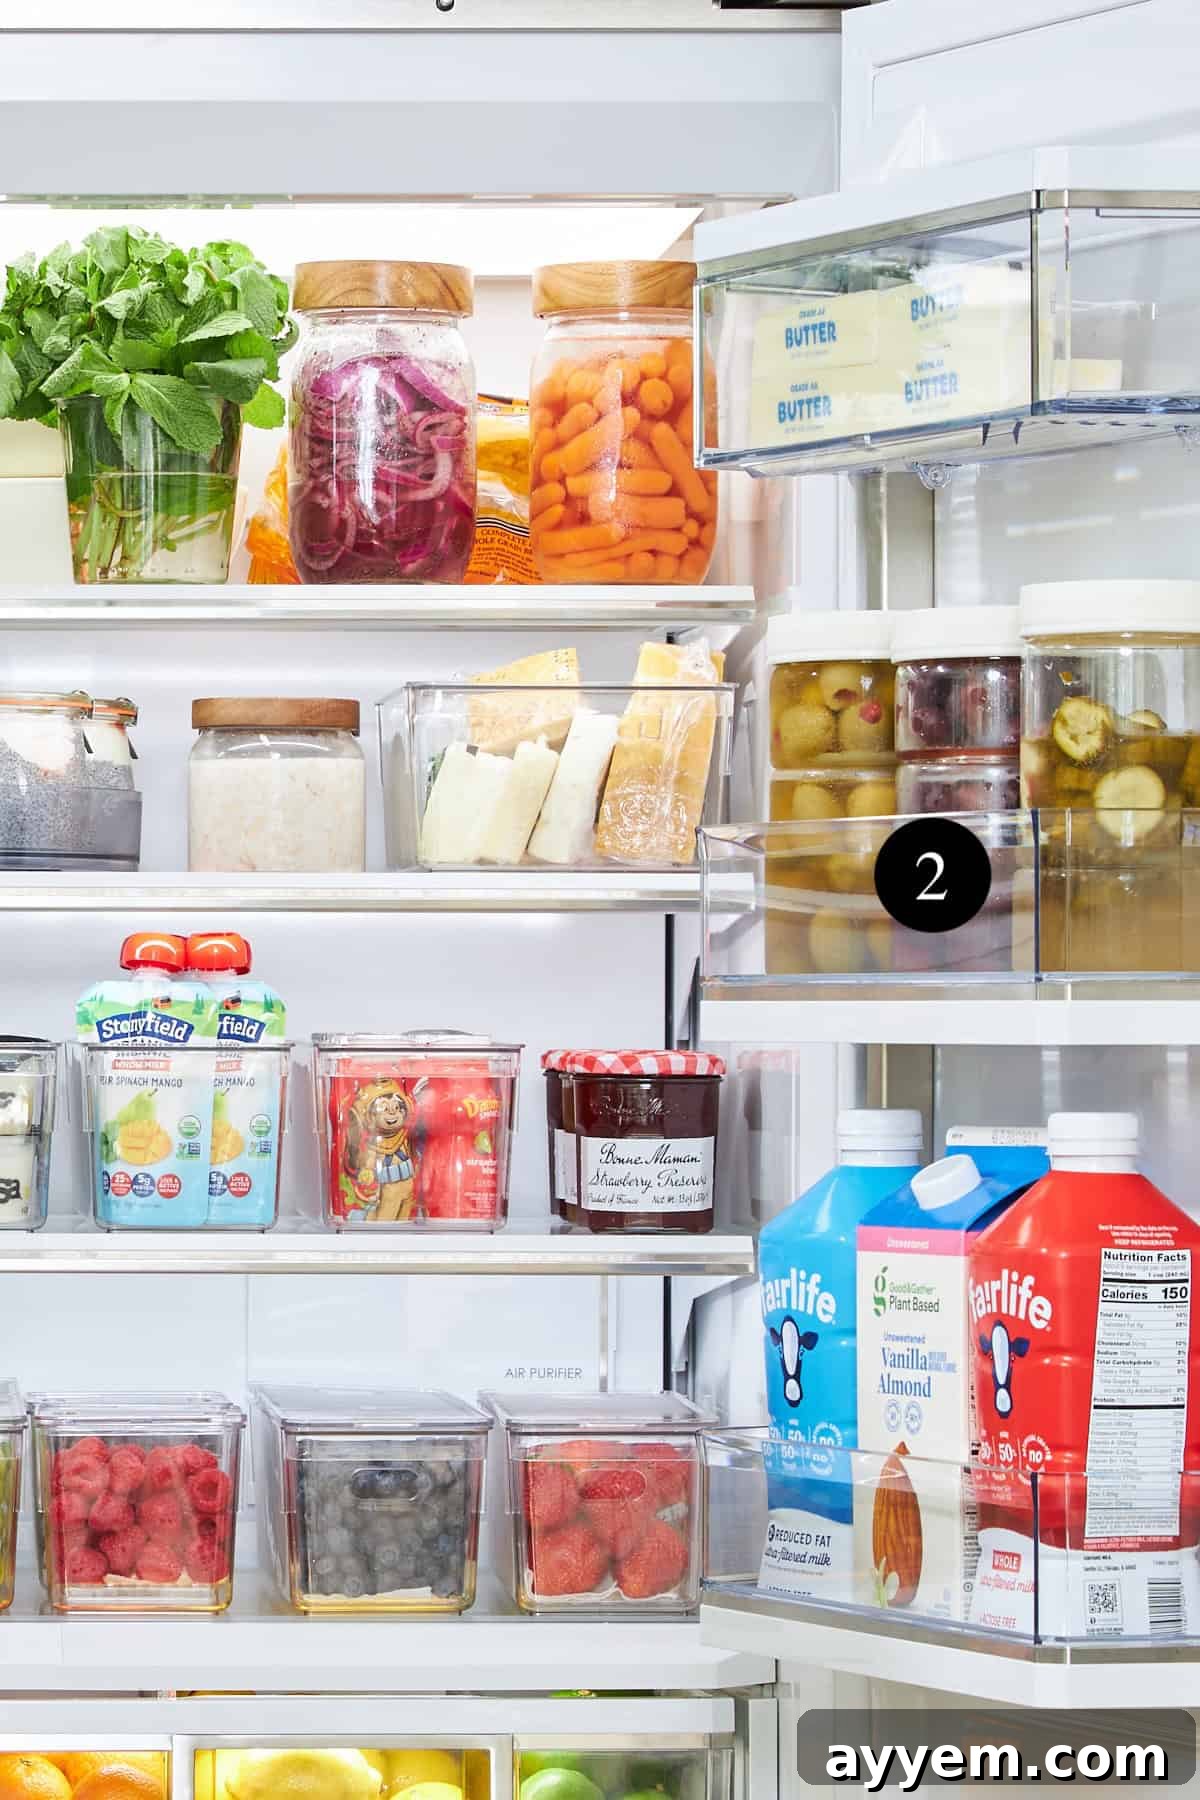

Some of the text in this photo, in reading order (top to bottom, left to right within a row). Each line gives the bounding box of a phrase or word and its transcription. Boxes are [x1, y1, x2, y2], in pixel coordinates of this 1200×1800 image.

[785, 320, 837, 349] BUTTER
[904, 372, 959, 403] BUTTER
[777, 395, 831, 424] BUTTER
[102, 1012, 188, 1040] Stonyfield
[116, 1076, 148, 1087] SPINACH
[152, 1077, 183, 1088] MANGO
[600, 1143, 701, 1165] Bonne Maman
[588, 1168, 652, 1194] Strawberry
[1103, 1251, 1187, 1262] Nutrition Facts
[1102, 1288, 1148, 1300] Calories
[1161, 1286, 1188, 1300] 150
[889, 1296, 940, 1313] Plant Based
[881, 1347, 928, 1371] Vanilla
[504, 1367, 584, 1379] AIR PURIFIER
[878, 1374, 932, 1398] Almond
[1029, 1450, 1043, 1463] no
[775, 1529, 812, 1545] REDUCED
[815, 1535, 832, 1548] FAT
[808, 1552, 832, 1567] milk
[994, 1552, 1018, 1569] WHOLE
